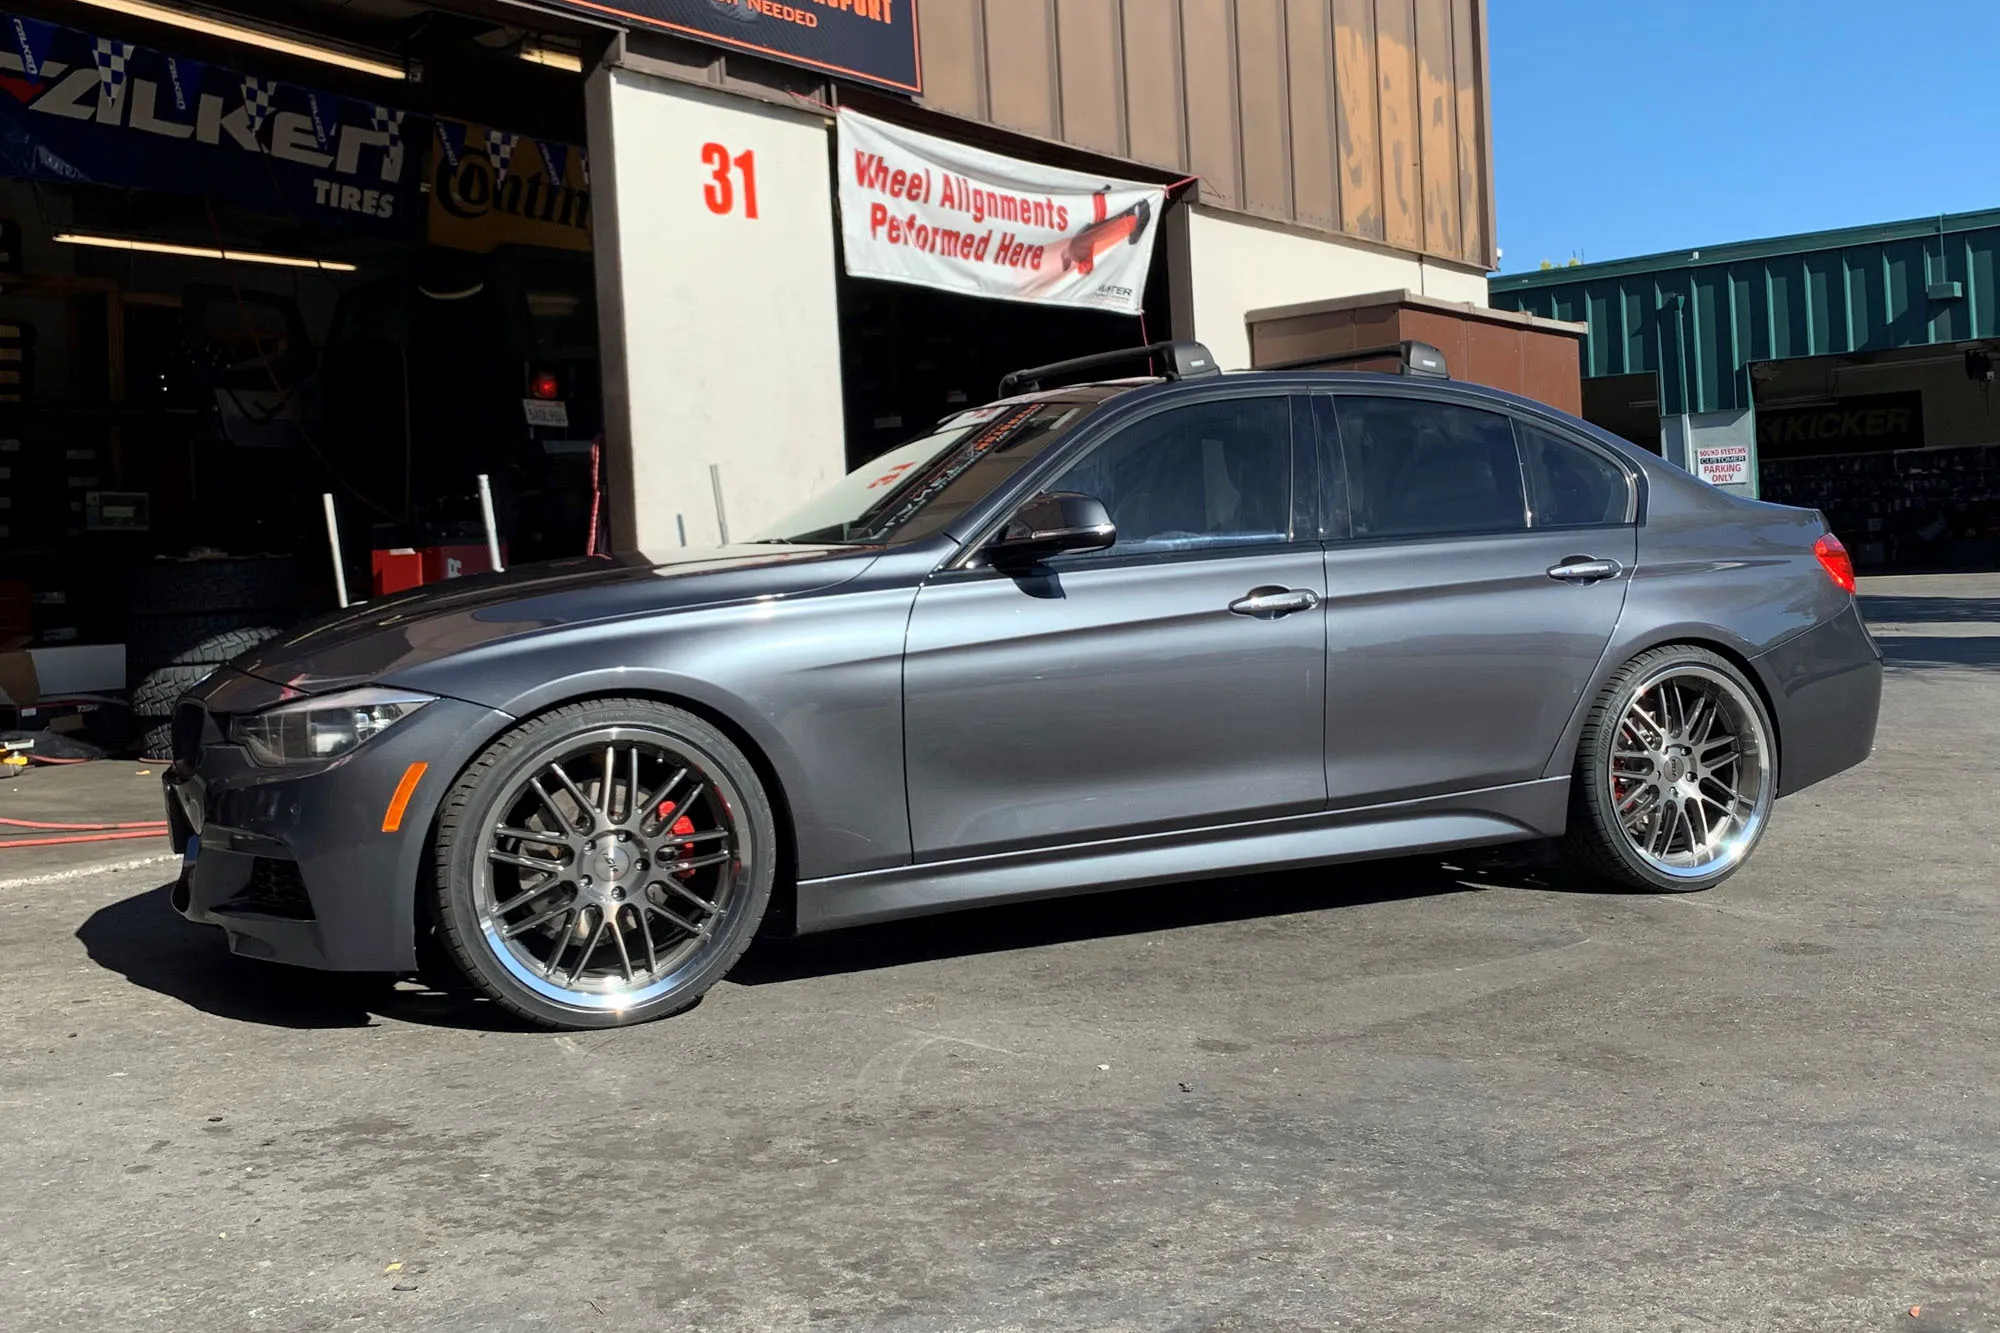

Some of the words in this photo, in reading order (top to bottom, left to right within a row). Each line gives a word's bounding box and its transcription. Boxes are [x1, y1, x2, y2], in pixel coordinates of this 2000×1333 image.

[747, 0, 818, 27] NEEDED
[701, 142, 758, 219] 31
[854, 148, 931, 204] Wheel
[940, 173, 1068, 232] Alignments
[313, 178, 395, 219] TIRES
[994, 231, 1044, 271] Here
[1784, 407, 1913, 443] KICKER
[1700, 449, 1719, 457] SOUND
[1720, 447, 1745, 455] SYSTEMS
[1701, 456, 1745, 464] CUSTOMER
[1704, 464, 1741, 473] PARKING
[1712, 473, 1734, 482] ONLY
